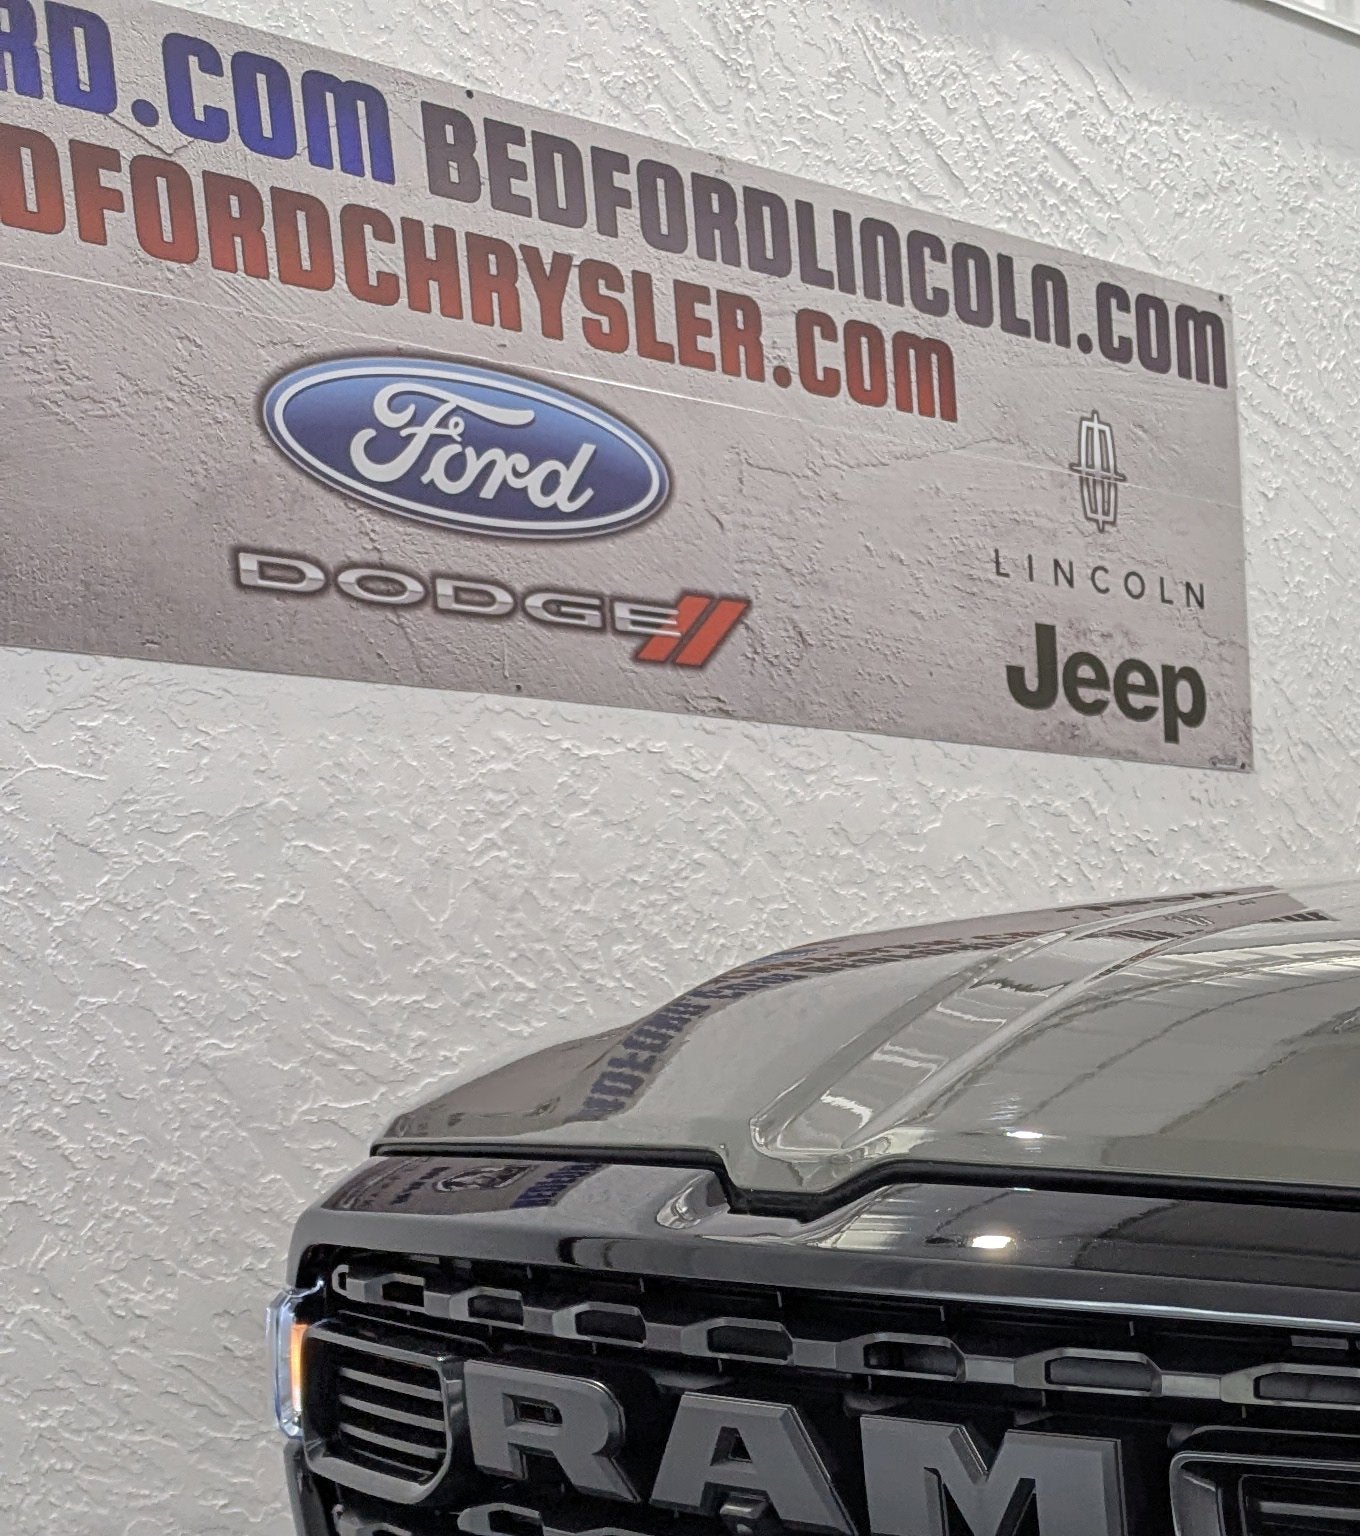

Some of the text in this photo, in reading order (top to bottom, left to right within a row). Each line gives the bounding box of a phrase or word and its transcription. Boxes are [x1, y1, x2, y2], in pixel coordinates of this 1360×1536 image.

[0, 123, 958, 423] DFORDCHRYSLER.COM
[350, 381, 595, 513] Ford
[236, 550, 682, 638] DODGE
[995, 549, 1206, 609] LINCOLN
[1006, 622, 1208, 744] Jeep
